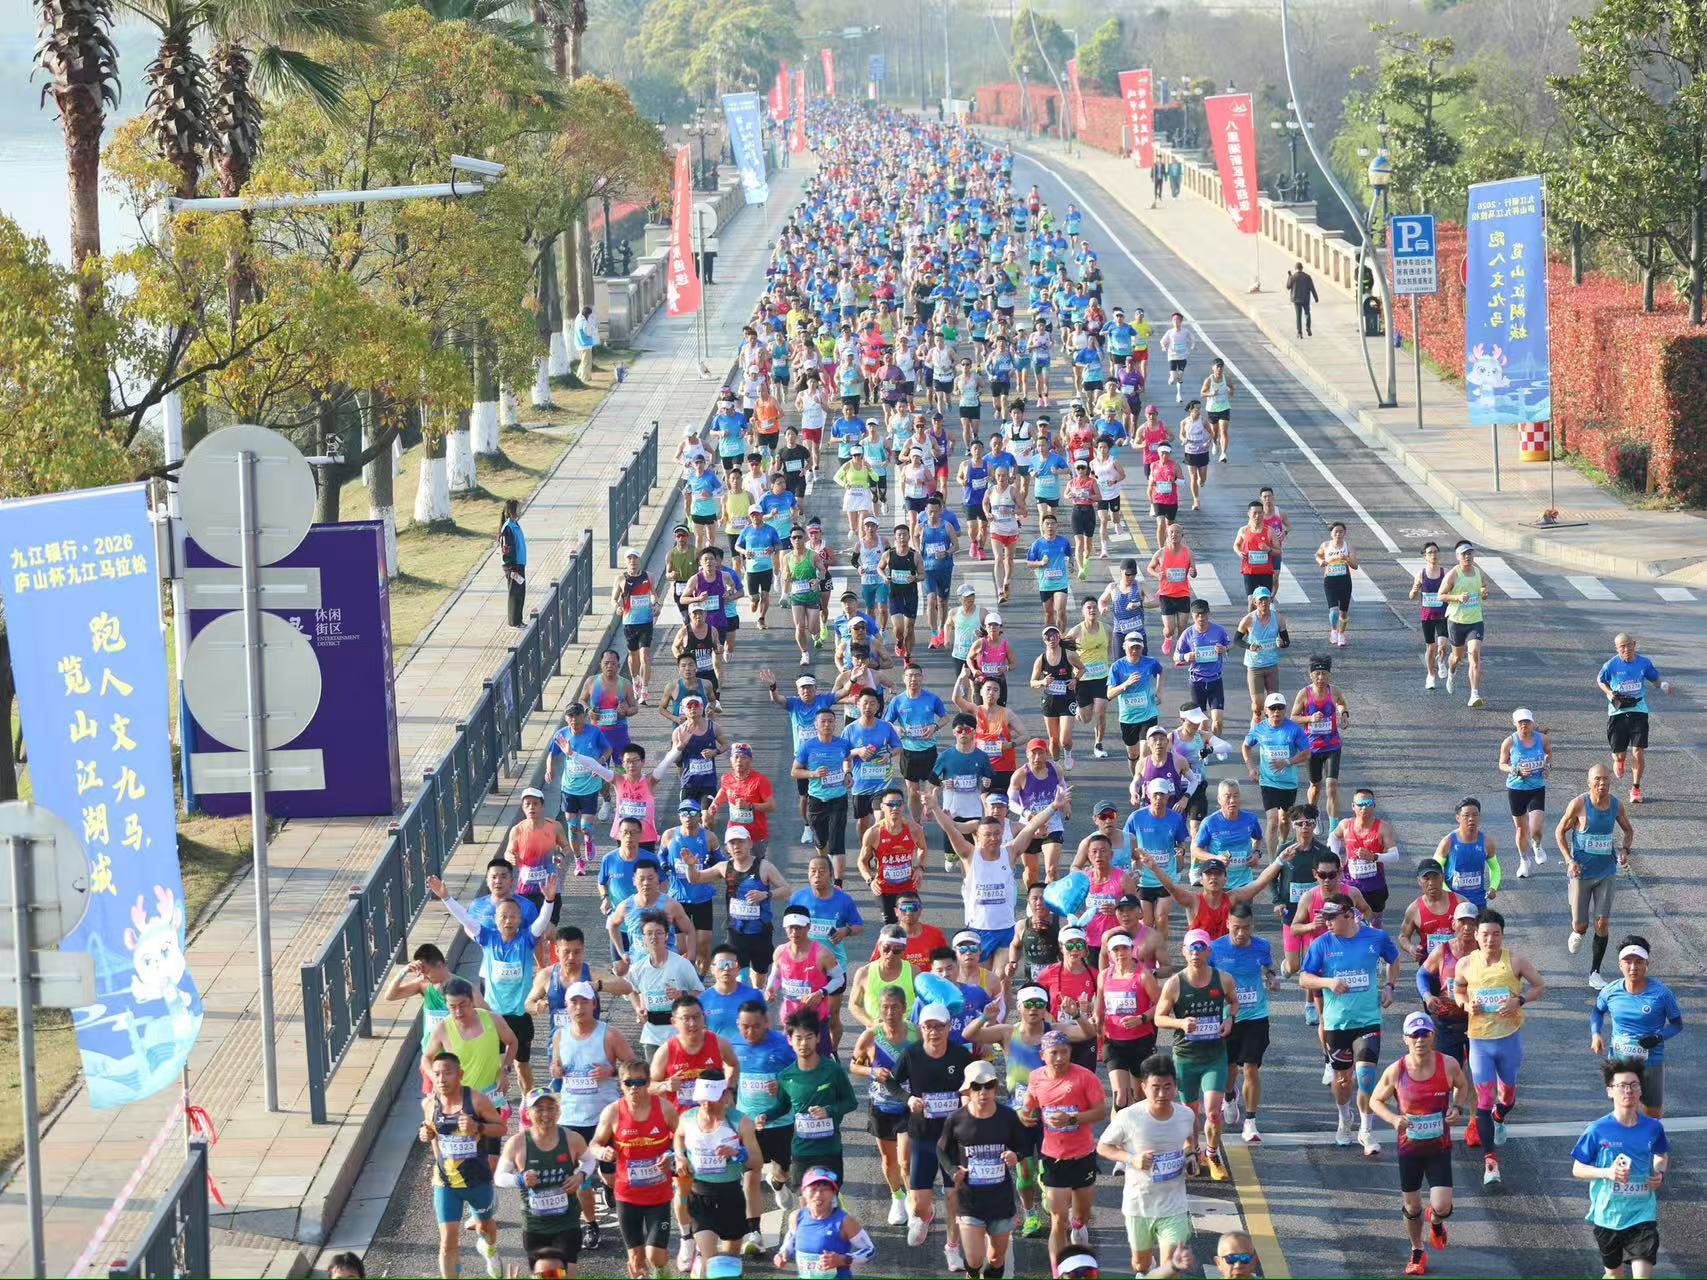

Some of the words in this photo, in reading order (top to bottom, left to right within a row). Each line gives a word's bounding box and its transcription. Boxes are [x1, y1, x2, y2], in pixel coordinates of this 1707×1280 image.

[1396, 221, 1422, 253] P
[15, 554, 147, 593] 庐山杯九江马拉松
[315, 608, 341, 622] 休闲
[315, 622, 342, 635] 街区
[57, 655, 118, 897] 览山江湖城
[501, 968, 521, 976] 22147
[934, 1100, 958, 1108] 10426
[1417, 1121, 1441, 1130] 20191
[450, 1143, 474, 1151] 15323
[965, 1144, 1005, 1157] TSINGHUA
[630, 1168, 637, 1176] A
[971, 1167, 977, 1175] A
[981, 1166, 1003, 1175] 19274
[1153, 1165, 1160, 1173] A
[1613, 1182, 1620, 1191] B
[1624, 1183, 1648, 1192] 26315
